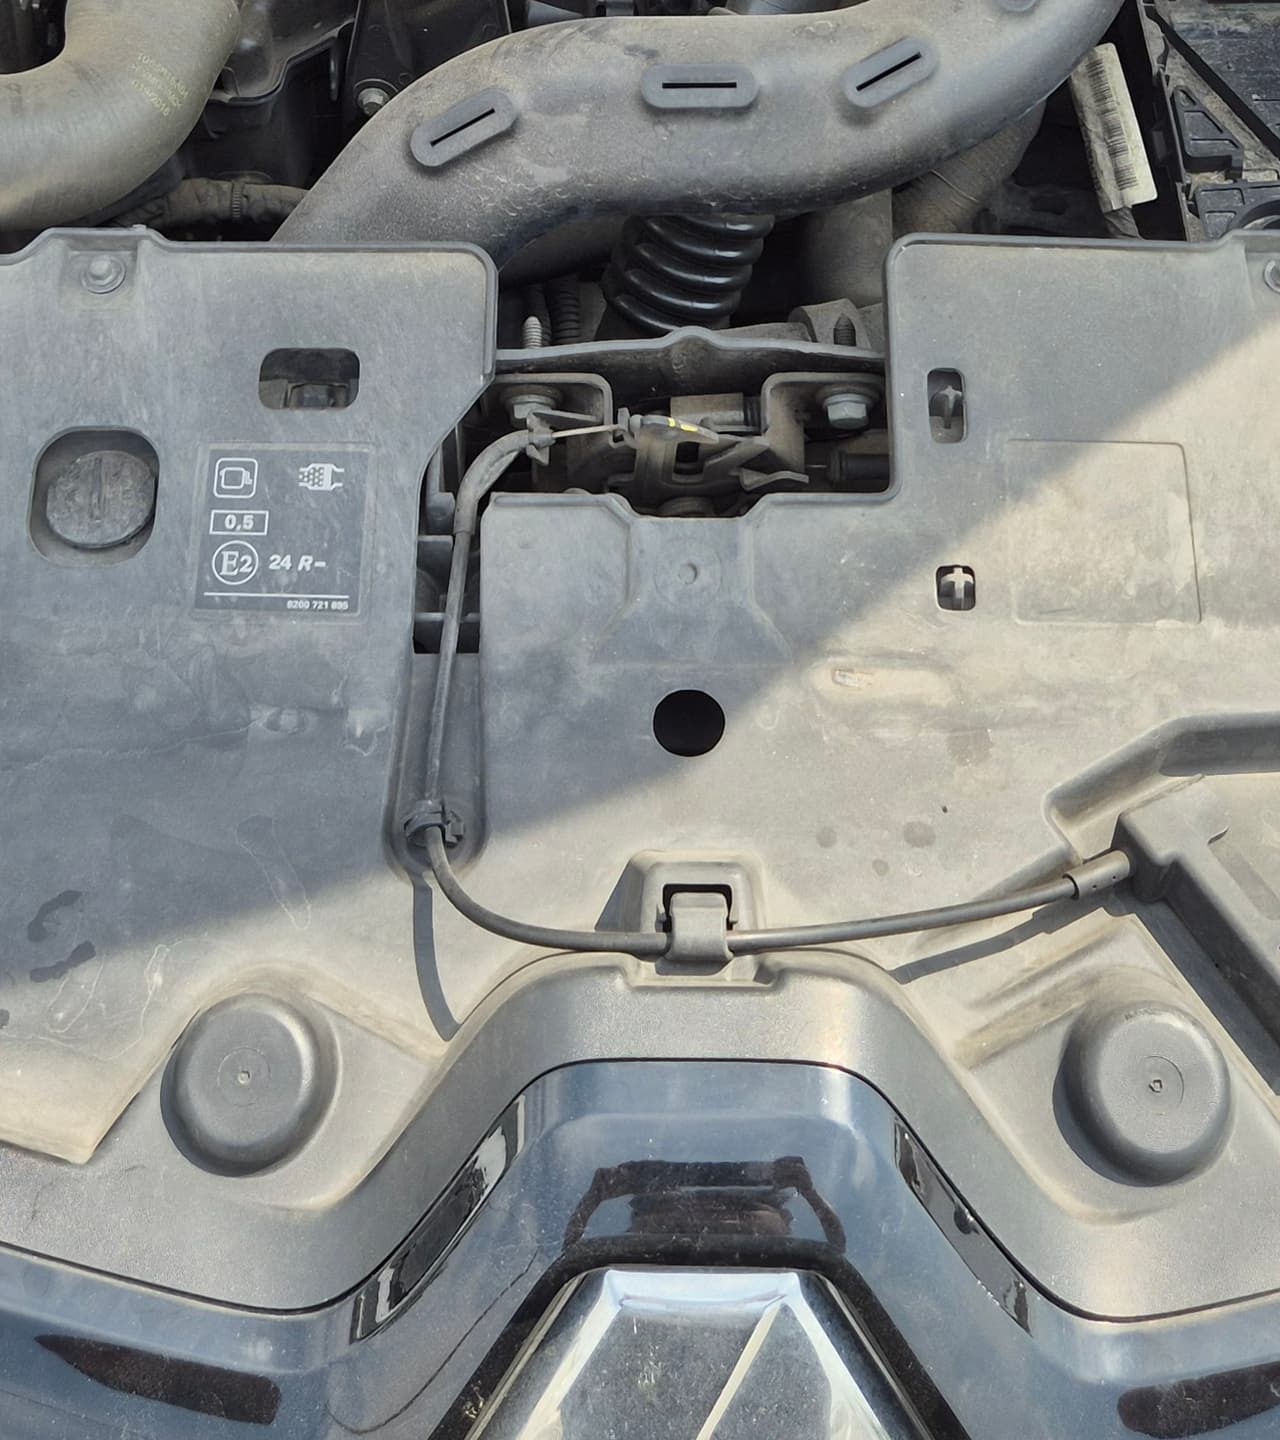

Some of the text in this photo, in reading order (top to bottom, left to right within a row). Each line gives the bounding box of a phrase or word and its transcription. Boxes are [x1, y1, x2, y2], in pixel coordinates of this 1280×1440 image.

[223, 514, 254, 531] 0,5
[219, 549, 254, 576] E2
[268, 554, 293, 571] 24
[311, 600, 329, 610] 721
